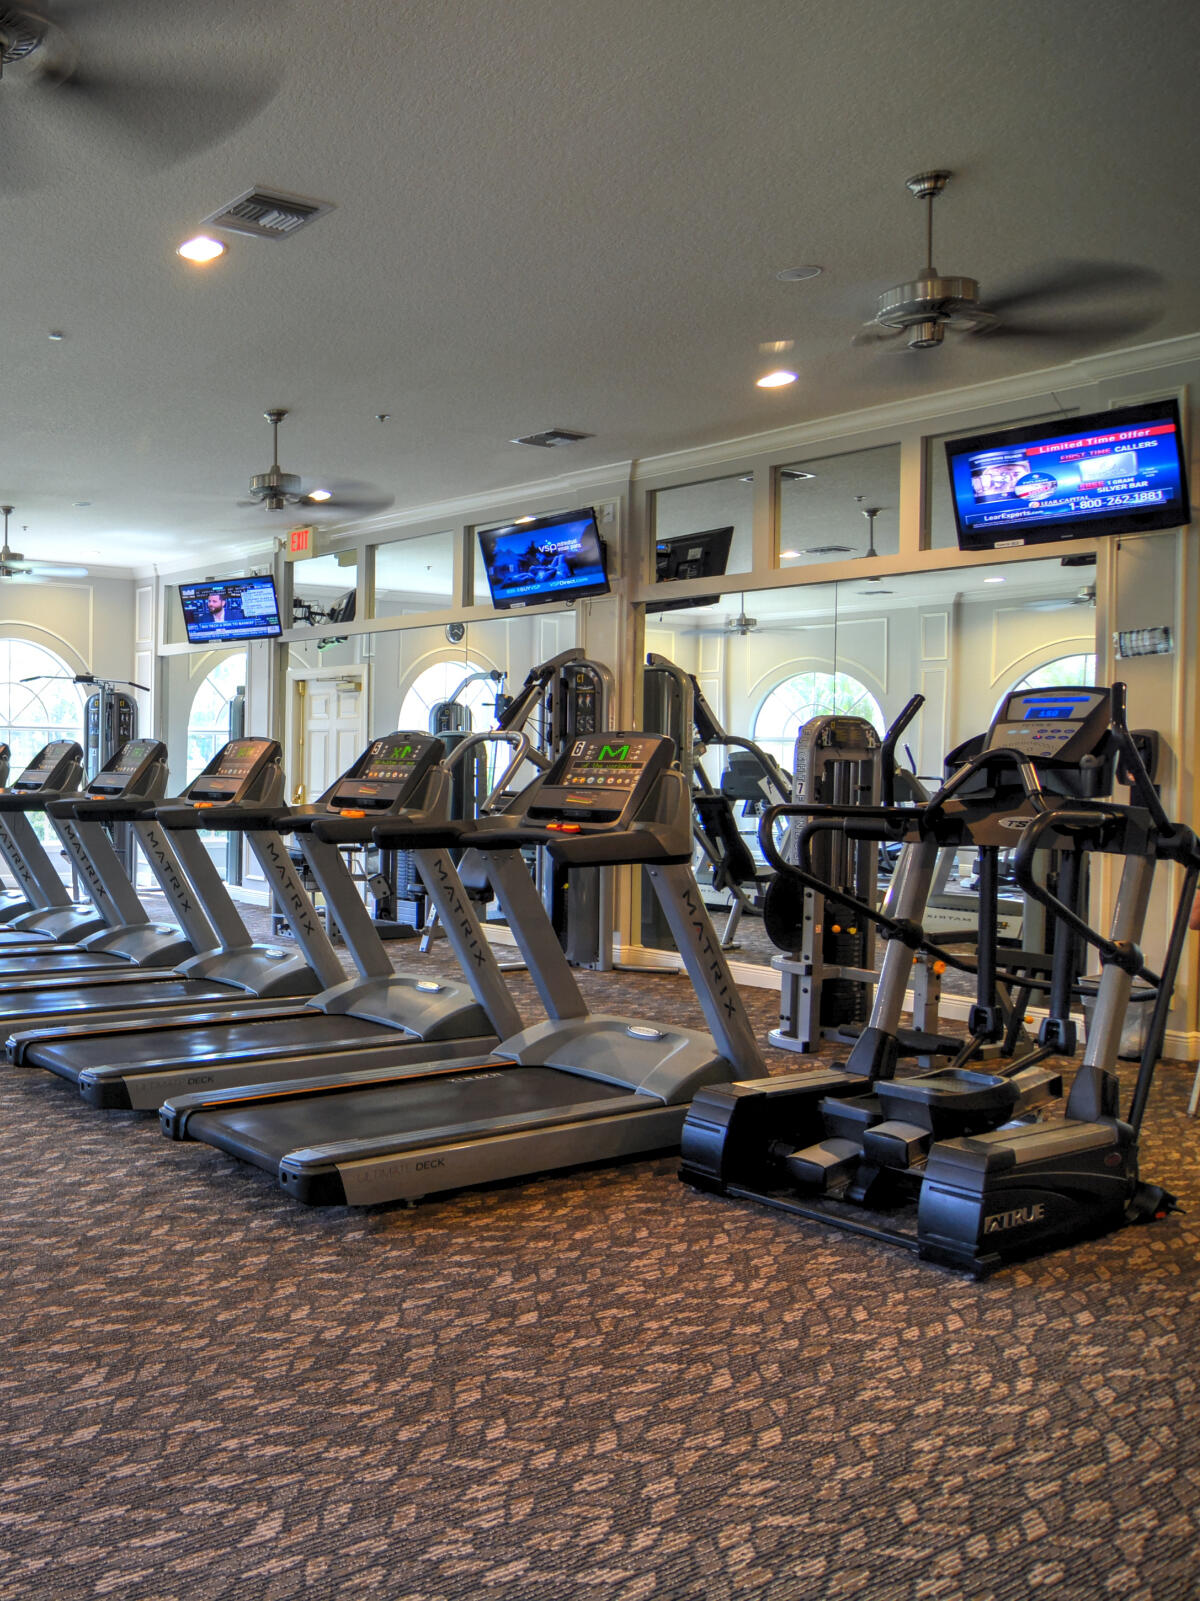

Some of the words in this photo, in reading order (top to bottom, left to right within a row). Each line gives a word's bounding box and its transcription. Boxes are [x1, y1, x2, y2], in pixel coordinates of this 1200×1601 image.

[1039, 440, 1083, 453] Limited
[1087, 435, 1116, 446] Time
[1119, 429, 1151, 440] Offer
[1114, 440, 1159, 453] CALLERS
[1097, 483, 1128, 493] SILVER
[1129, 481, 1149, 489] BAR
[291, 530, 310, 552] EXIT
[64, 824, 107, 896] MATRIX
[147, 831, 192, 913] MATRIX
[266, 843, 315, 936] MATRIX
[433, 858, 486, 967] MATRIX
[682, 890, 737, 1019] MATRIX
[415, 1157, 445, 1172] DECK
[1000, 1202, 1046, 1230] TRUE
